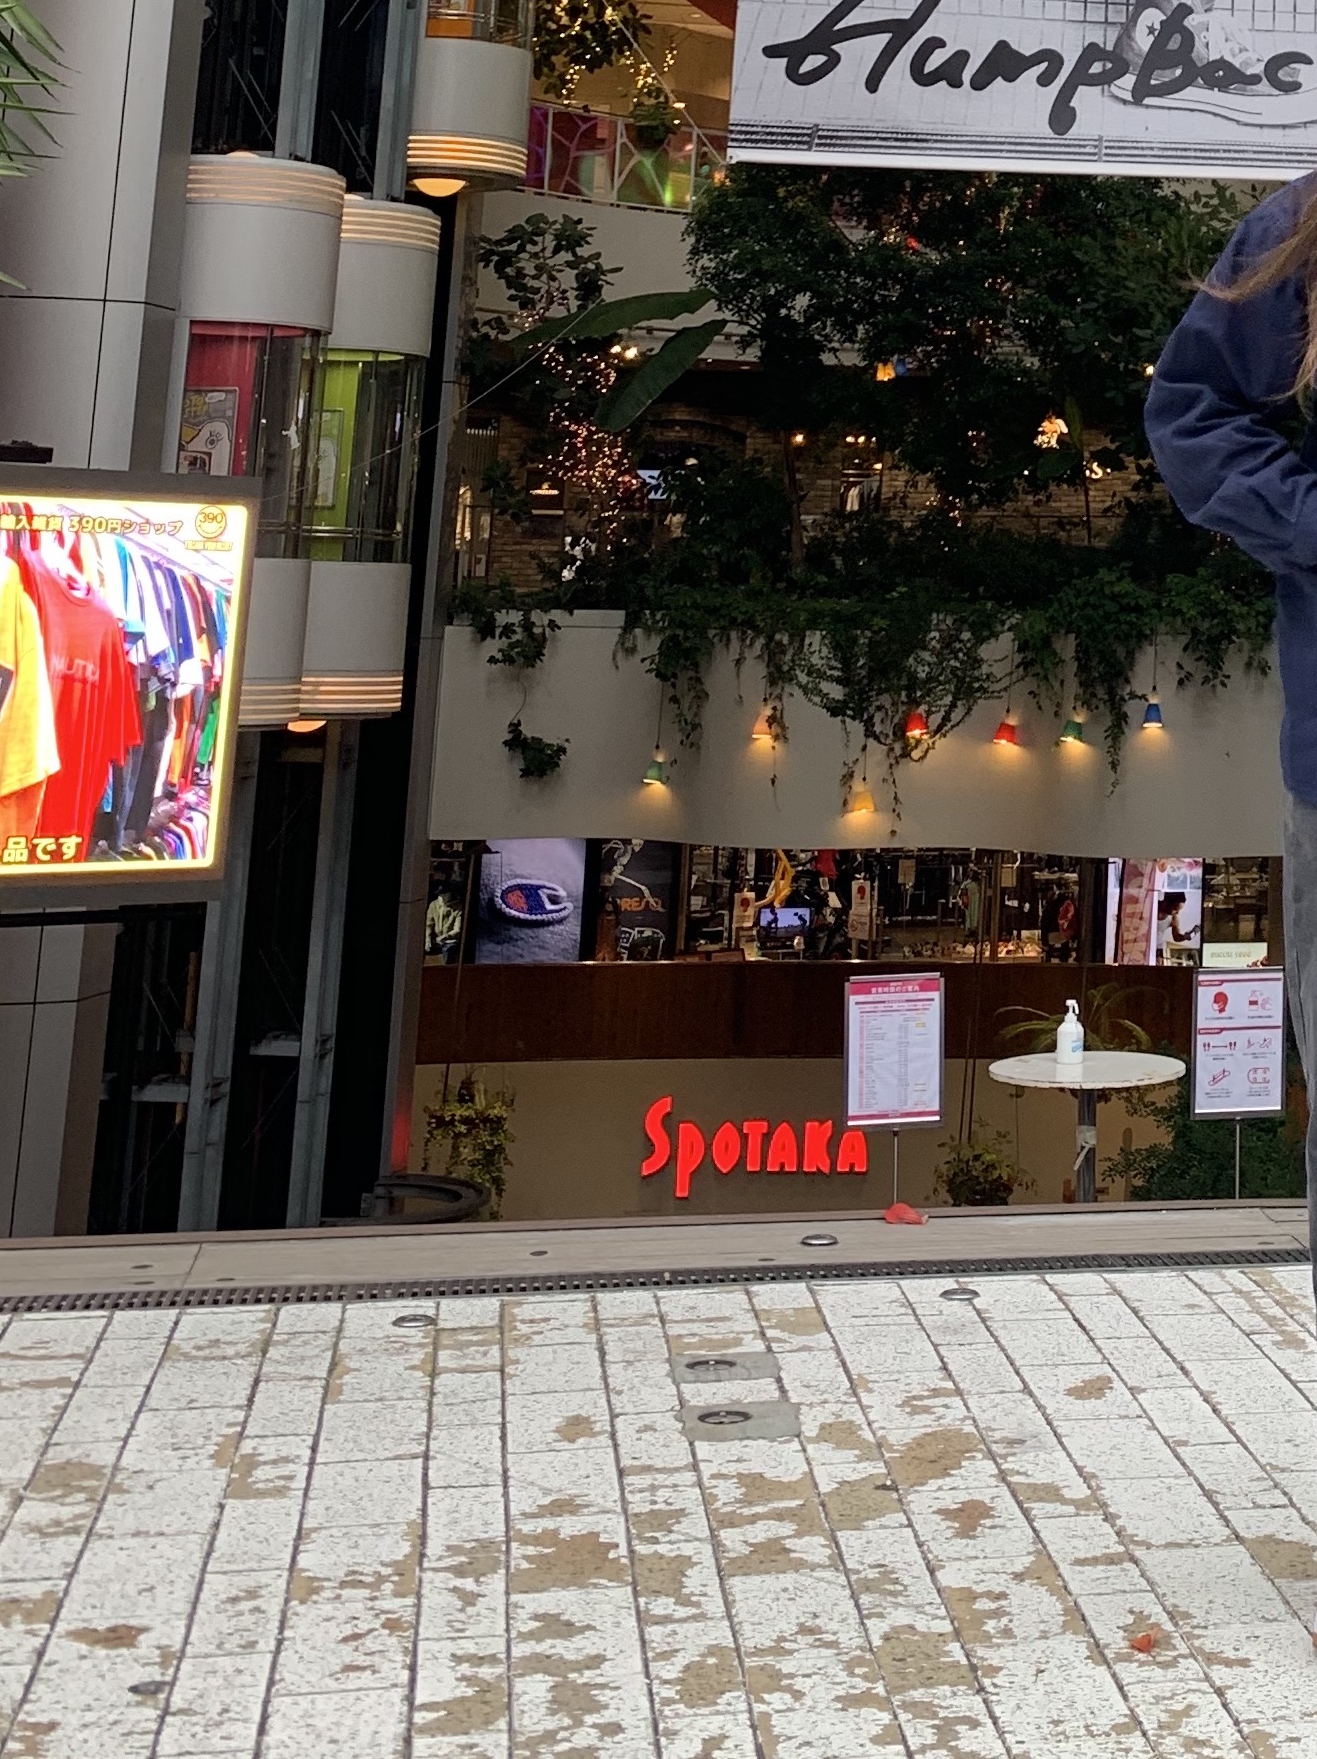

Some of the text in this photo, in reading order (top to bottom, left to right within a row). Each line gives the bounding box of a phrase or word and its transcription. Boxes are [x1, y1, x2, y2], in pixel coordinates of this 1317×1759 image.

[68, 515, 184, 537] 390円ショップ
[198, 511, 224, 524] 390
[1, 834, 84, 863] 品です
